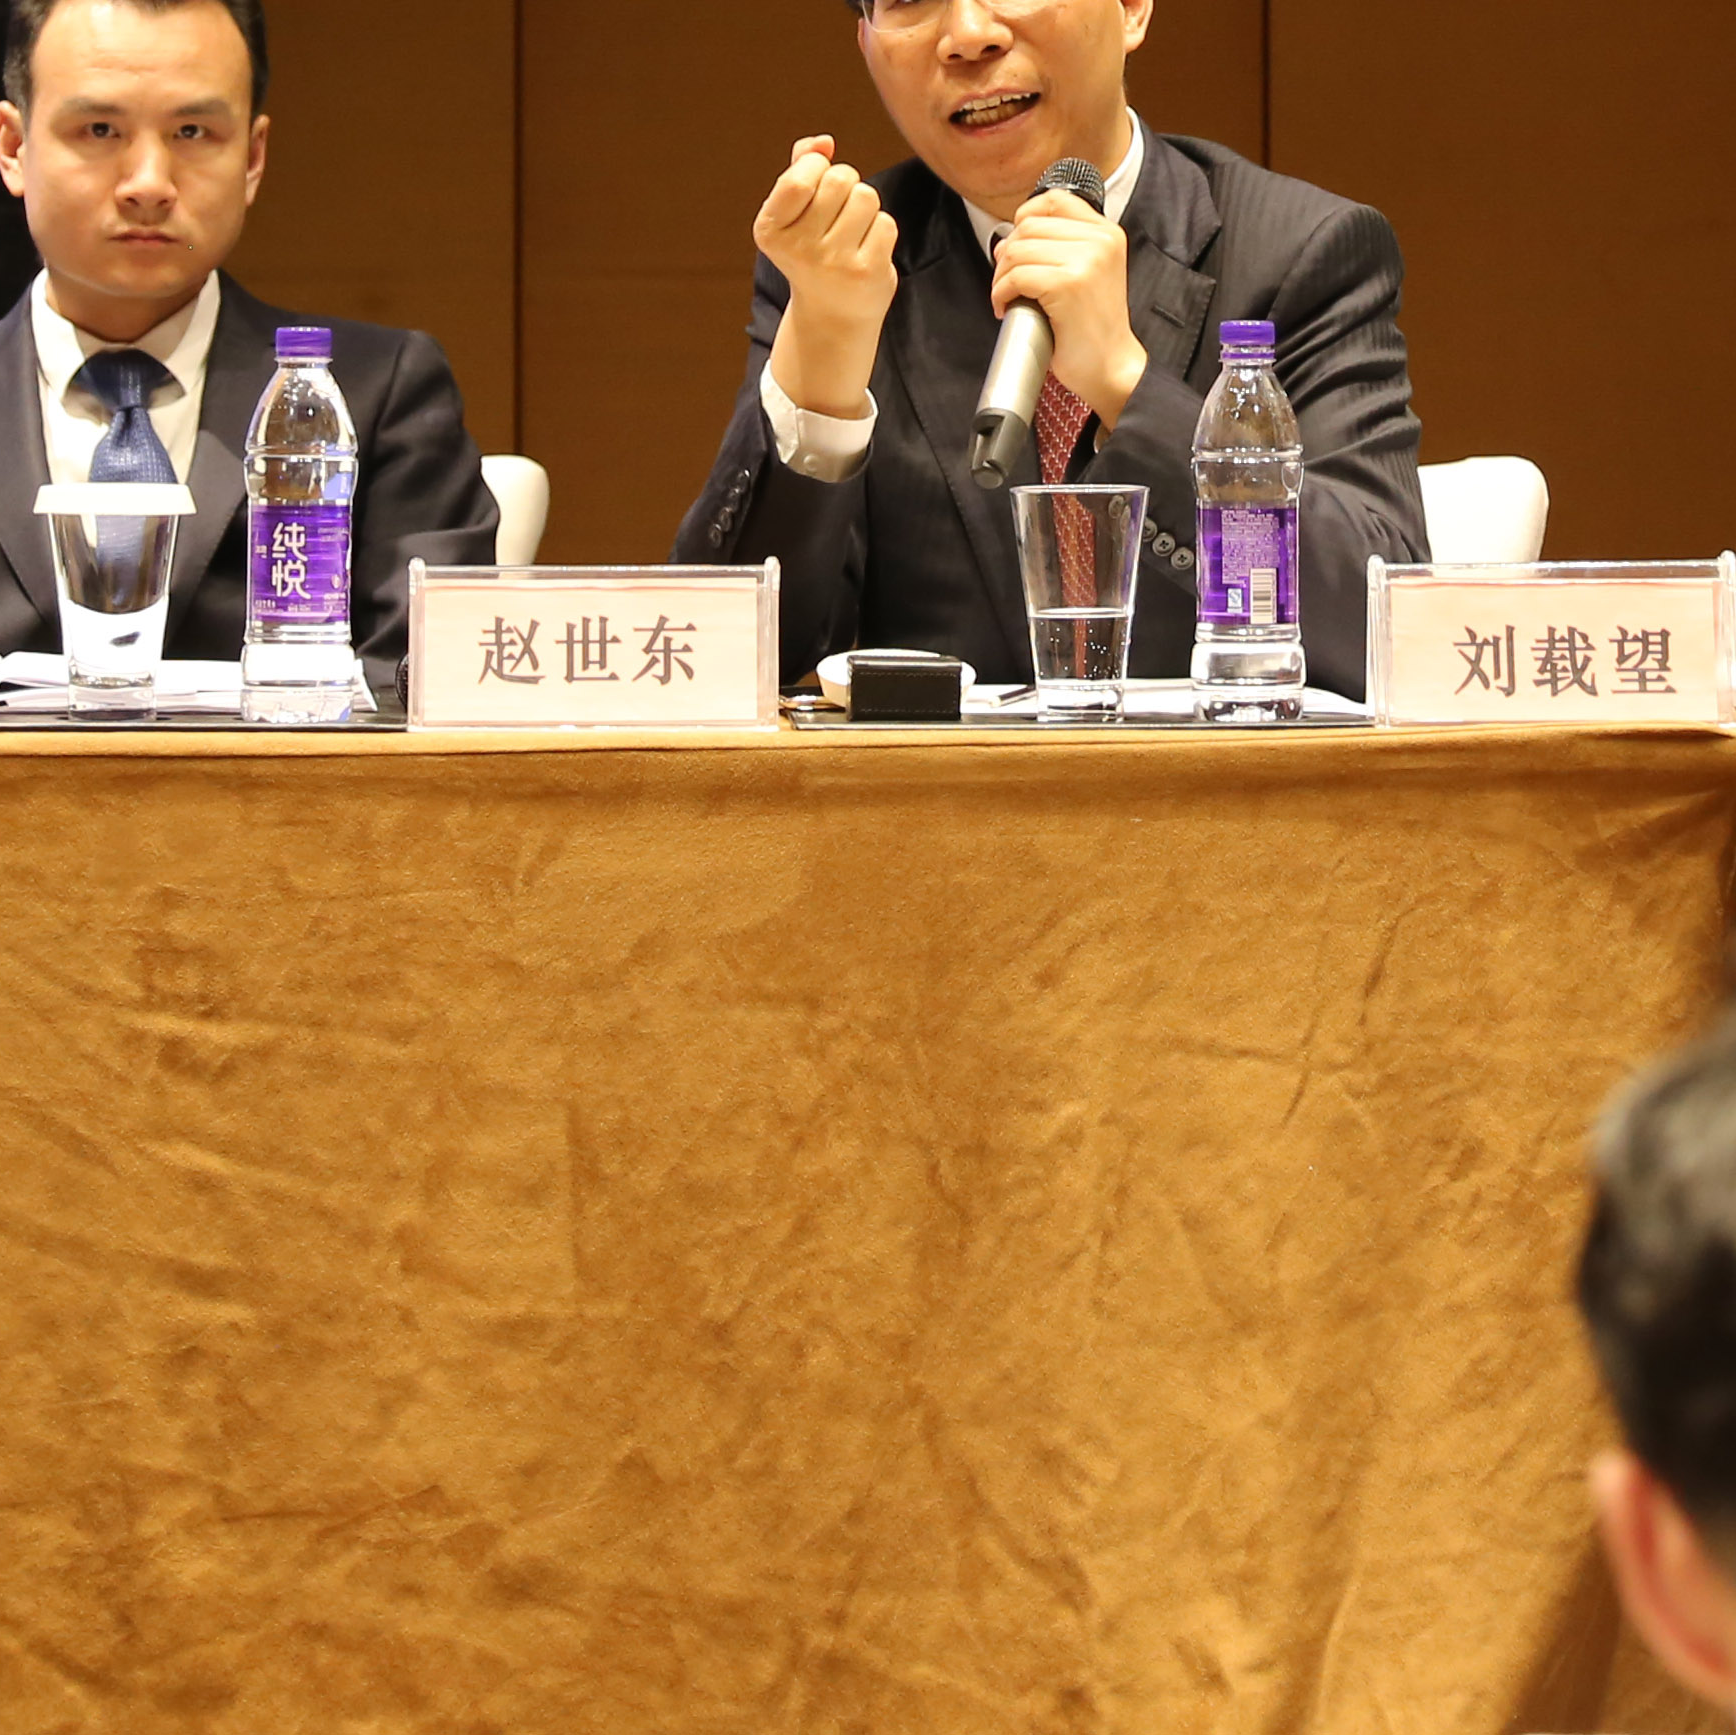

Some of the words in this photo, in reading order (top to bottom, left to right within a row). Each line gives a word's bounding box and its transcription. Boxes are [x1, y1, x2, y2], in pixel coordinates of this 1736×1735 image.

[272, 522, 312, 600] 纯悦
[478, 615, 697, 685] 赵世东
[1453, 625, 1677, 697] 刘载望
